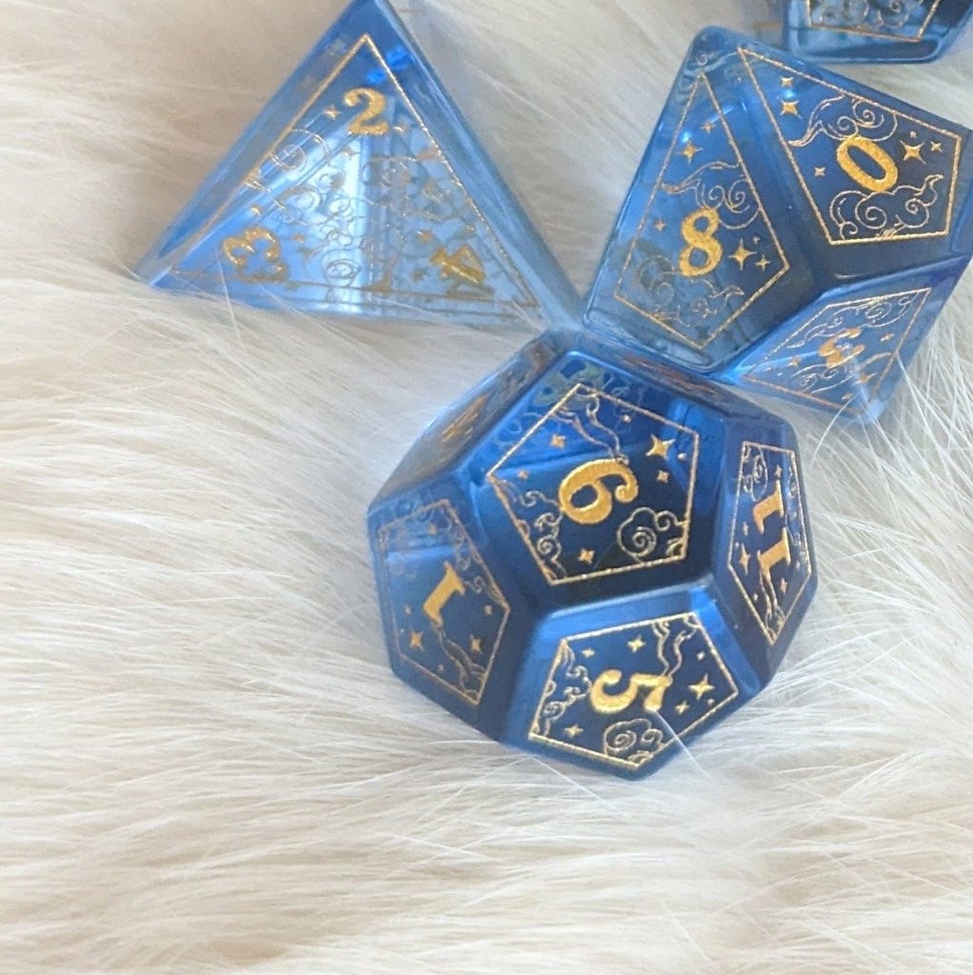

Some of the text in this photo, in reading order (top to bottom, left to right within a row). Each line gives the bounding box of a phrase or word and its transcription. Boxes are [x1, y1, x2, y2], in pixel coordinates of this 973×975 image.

[343, 87, 389, 136] 2
[836, 135, 898, 193] 0
[679, 206, 723, 277] 8
[753, 482, 791, 575] 11
[423, 561, 465, 625] 1
[588, 669, 671, 713] 5
